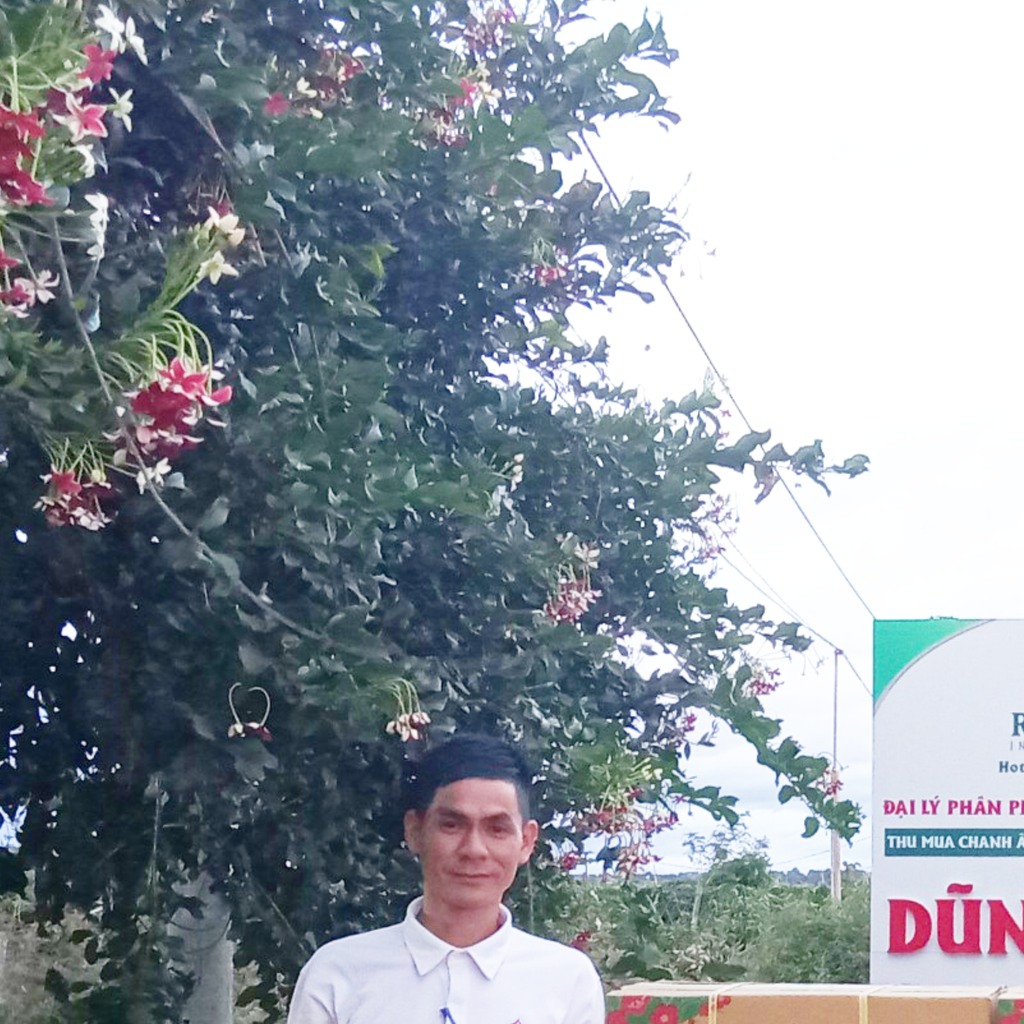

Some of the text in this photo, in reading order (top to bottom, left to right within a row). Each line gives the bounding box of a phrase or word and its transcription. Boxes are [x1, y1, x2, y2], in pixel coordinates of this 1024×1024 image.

[884, 800, 915, 819] ĐẠI
[921, 795, 940, 815] LÝ
[948, 796, 1001, 815] PHÂN
[887, 835, 917, 849] THU
[921, 835, 955, 849] MUA
[958, 835, 1012, 849] CHANH
